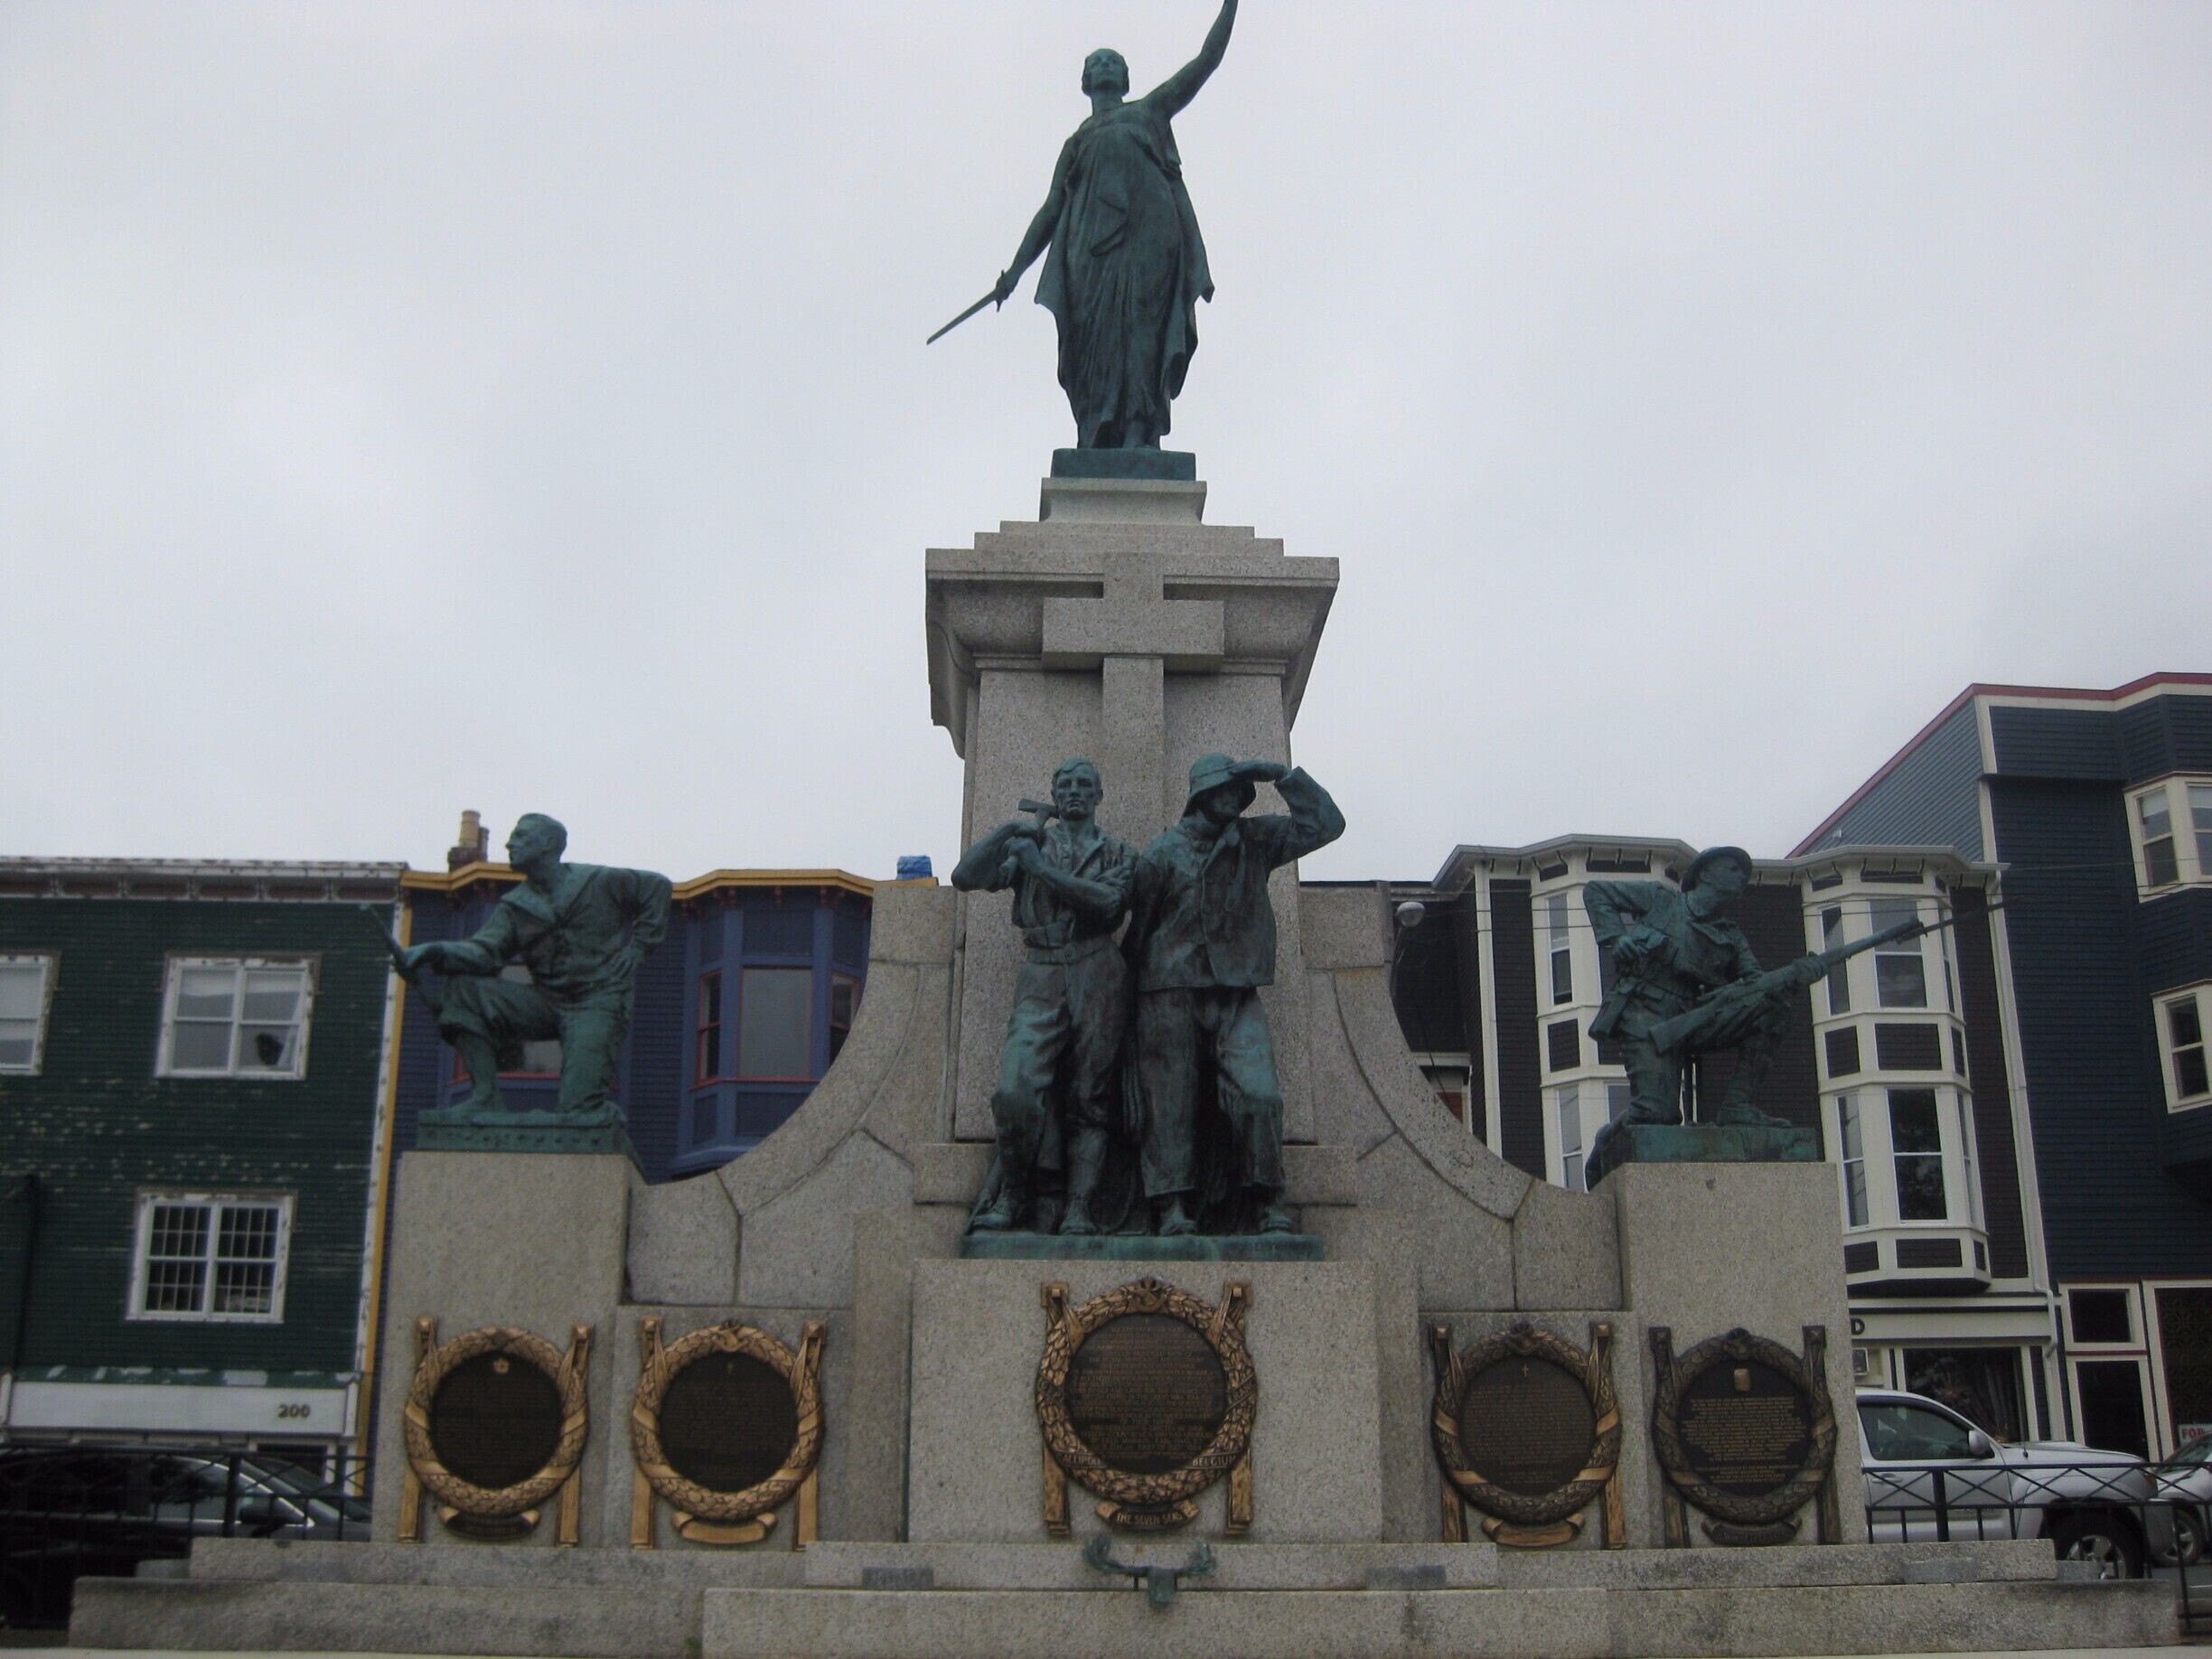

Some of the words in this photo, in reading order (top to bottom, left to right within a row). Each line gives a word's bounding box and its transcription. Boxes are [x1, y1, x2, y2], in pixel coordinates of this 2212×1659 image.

[276, 1402, 311, 1418] 200
[1192, 1454, 1236, 1467] BELGIUM
[1116, 1513, 1132, 1524] THE
[1135, 1514, 1159, 1525] SEVEN
[1162, 1511, 1183, 1523] SEAS
